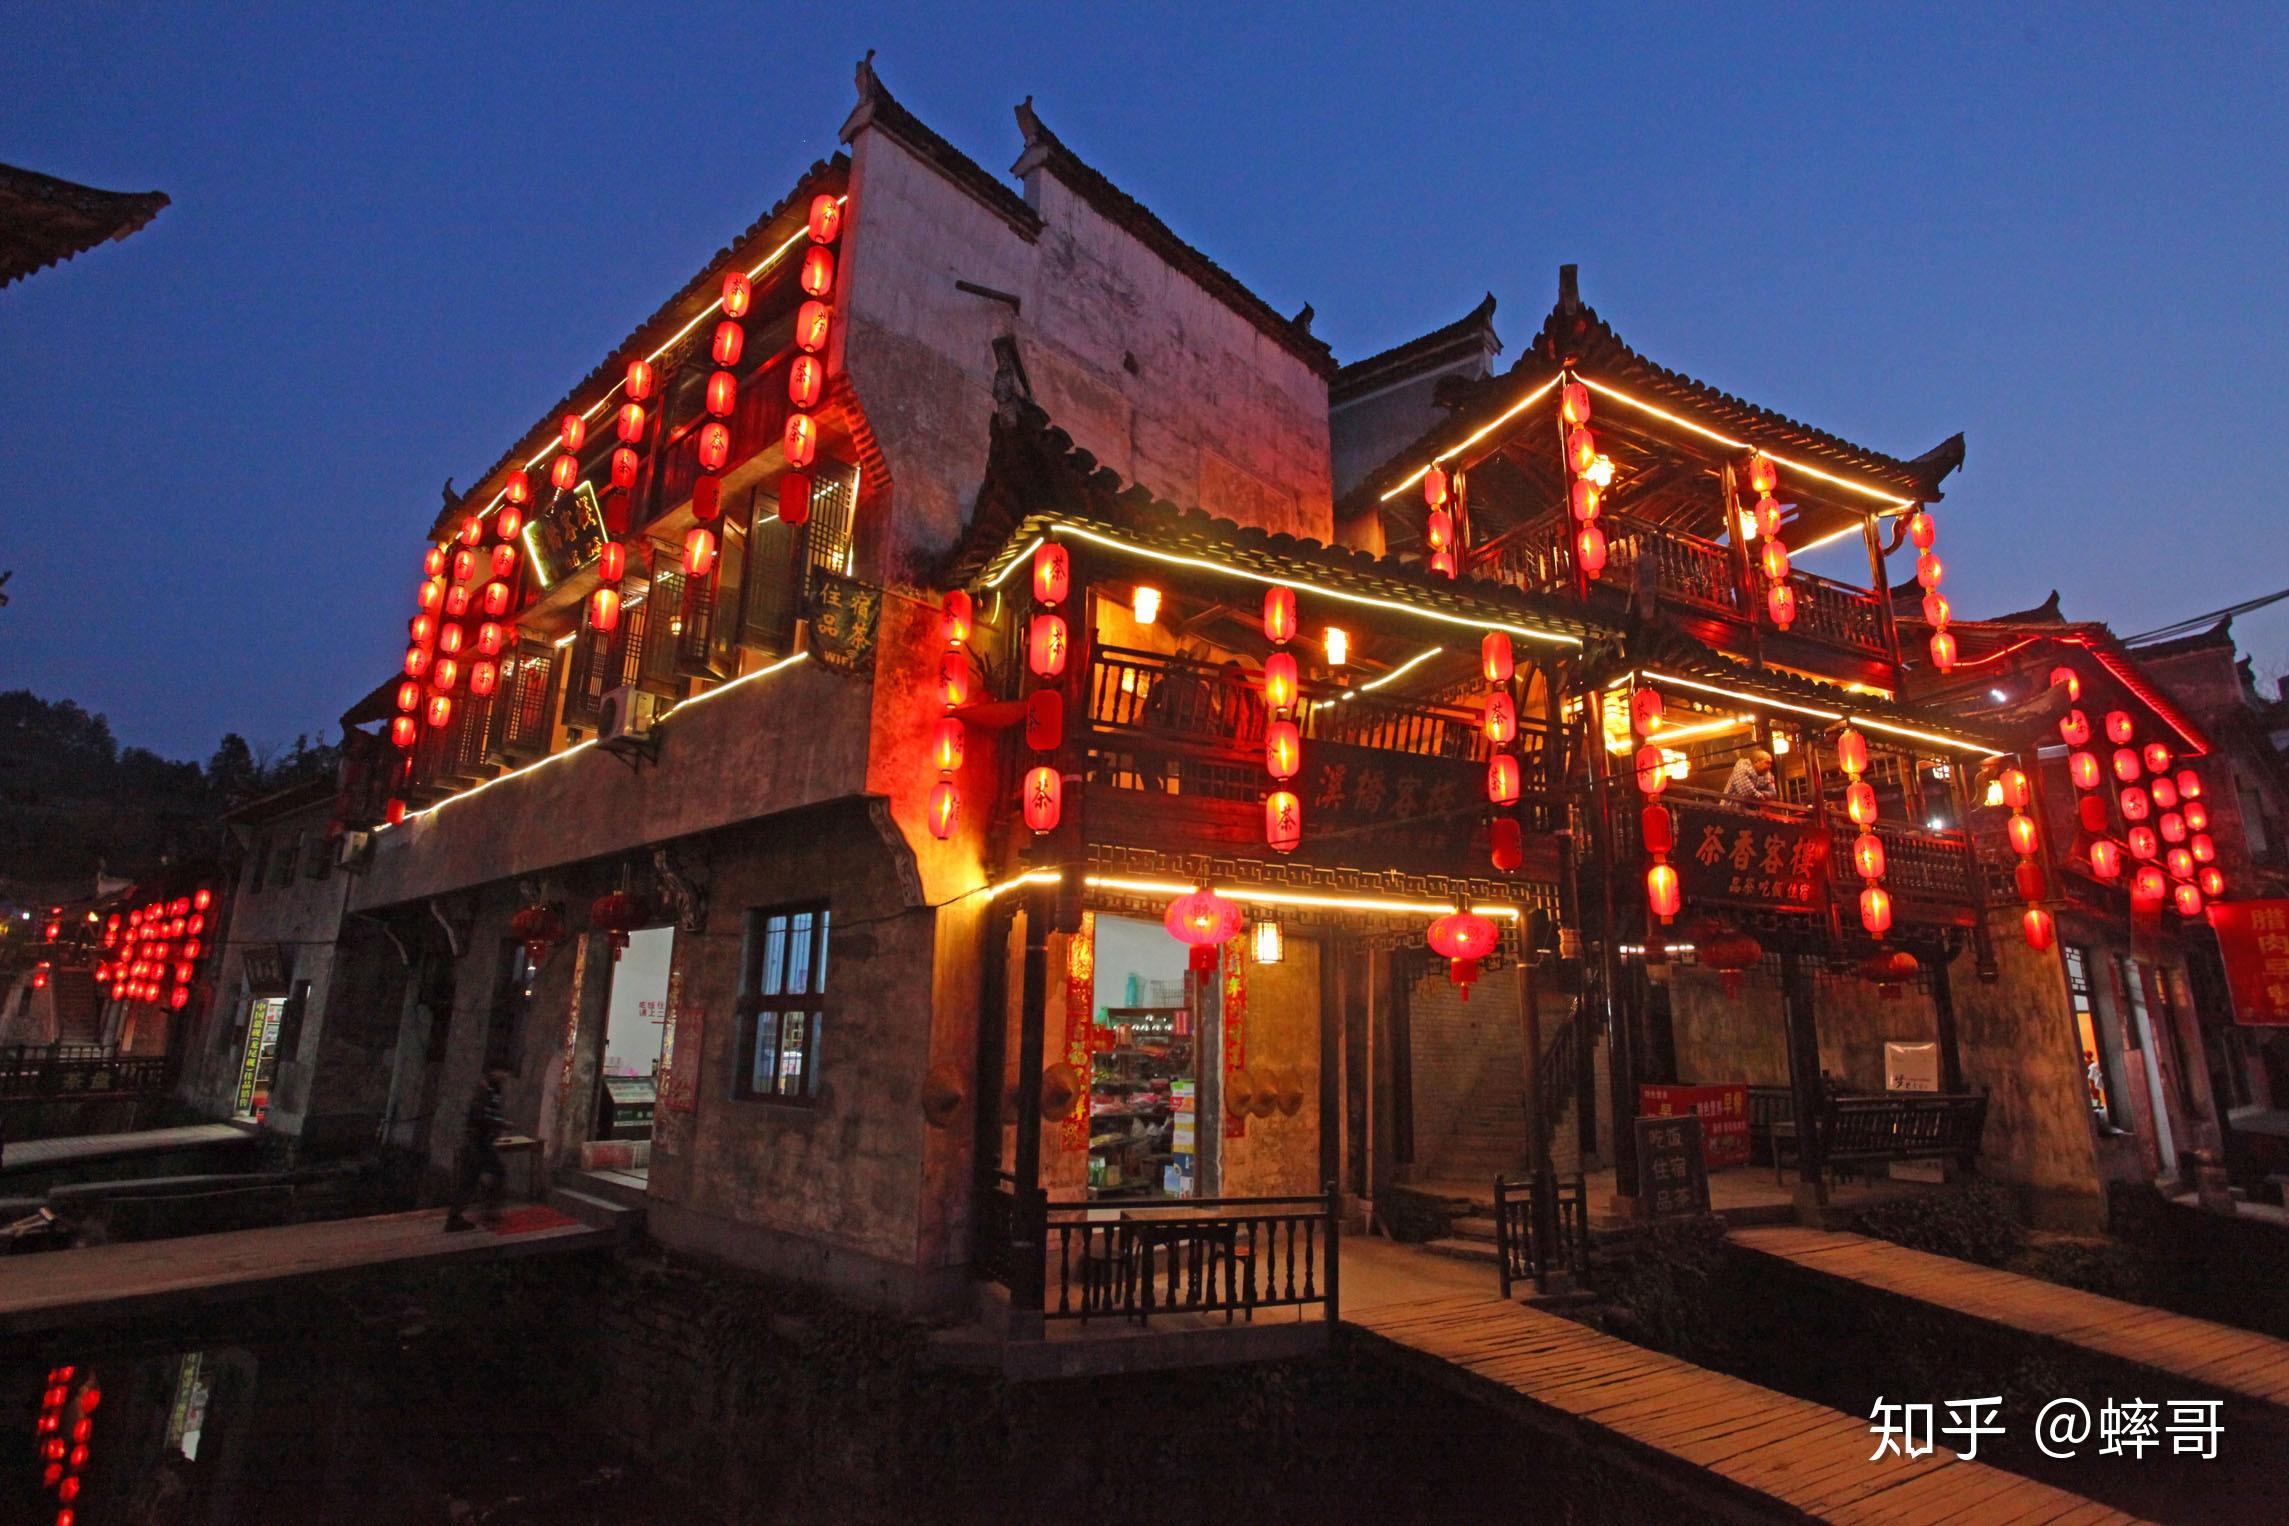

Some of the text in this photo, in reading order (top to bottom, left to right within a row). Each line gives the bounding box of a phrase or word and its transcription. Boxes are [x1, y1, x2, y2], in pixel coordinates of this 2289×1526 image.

[1052, 556, 1066, 581] 茶
[820, 582, 872, 620] 住宿
[817, 613, 873, 650] 品茶
[1050, 629, 1064, 654] 茶
[1493, 702, 1507, 724] 茶
[1032, 780, 1051, 809] 茶
[1278, 803, 1296, 831] 茶
[1651, 1155, 1687, 1180] 住宿
